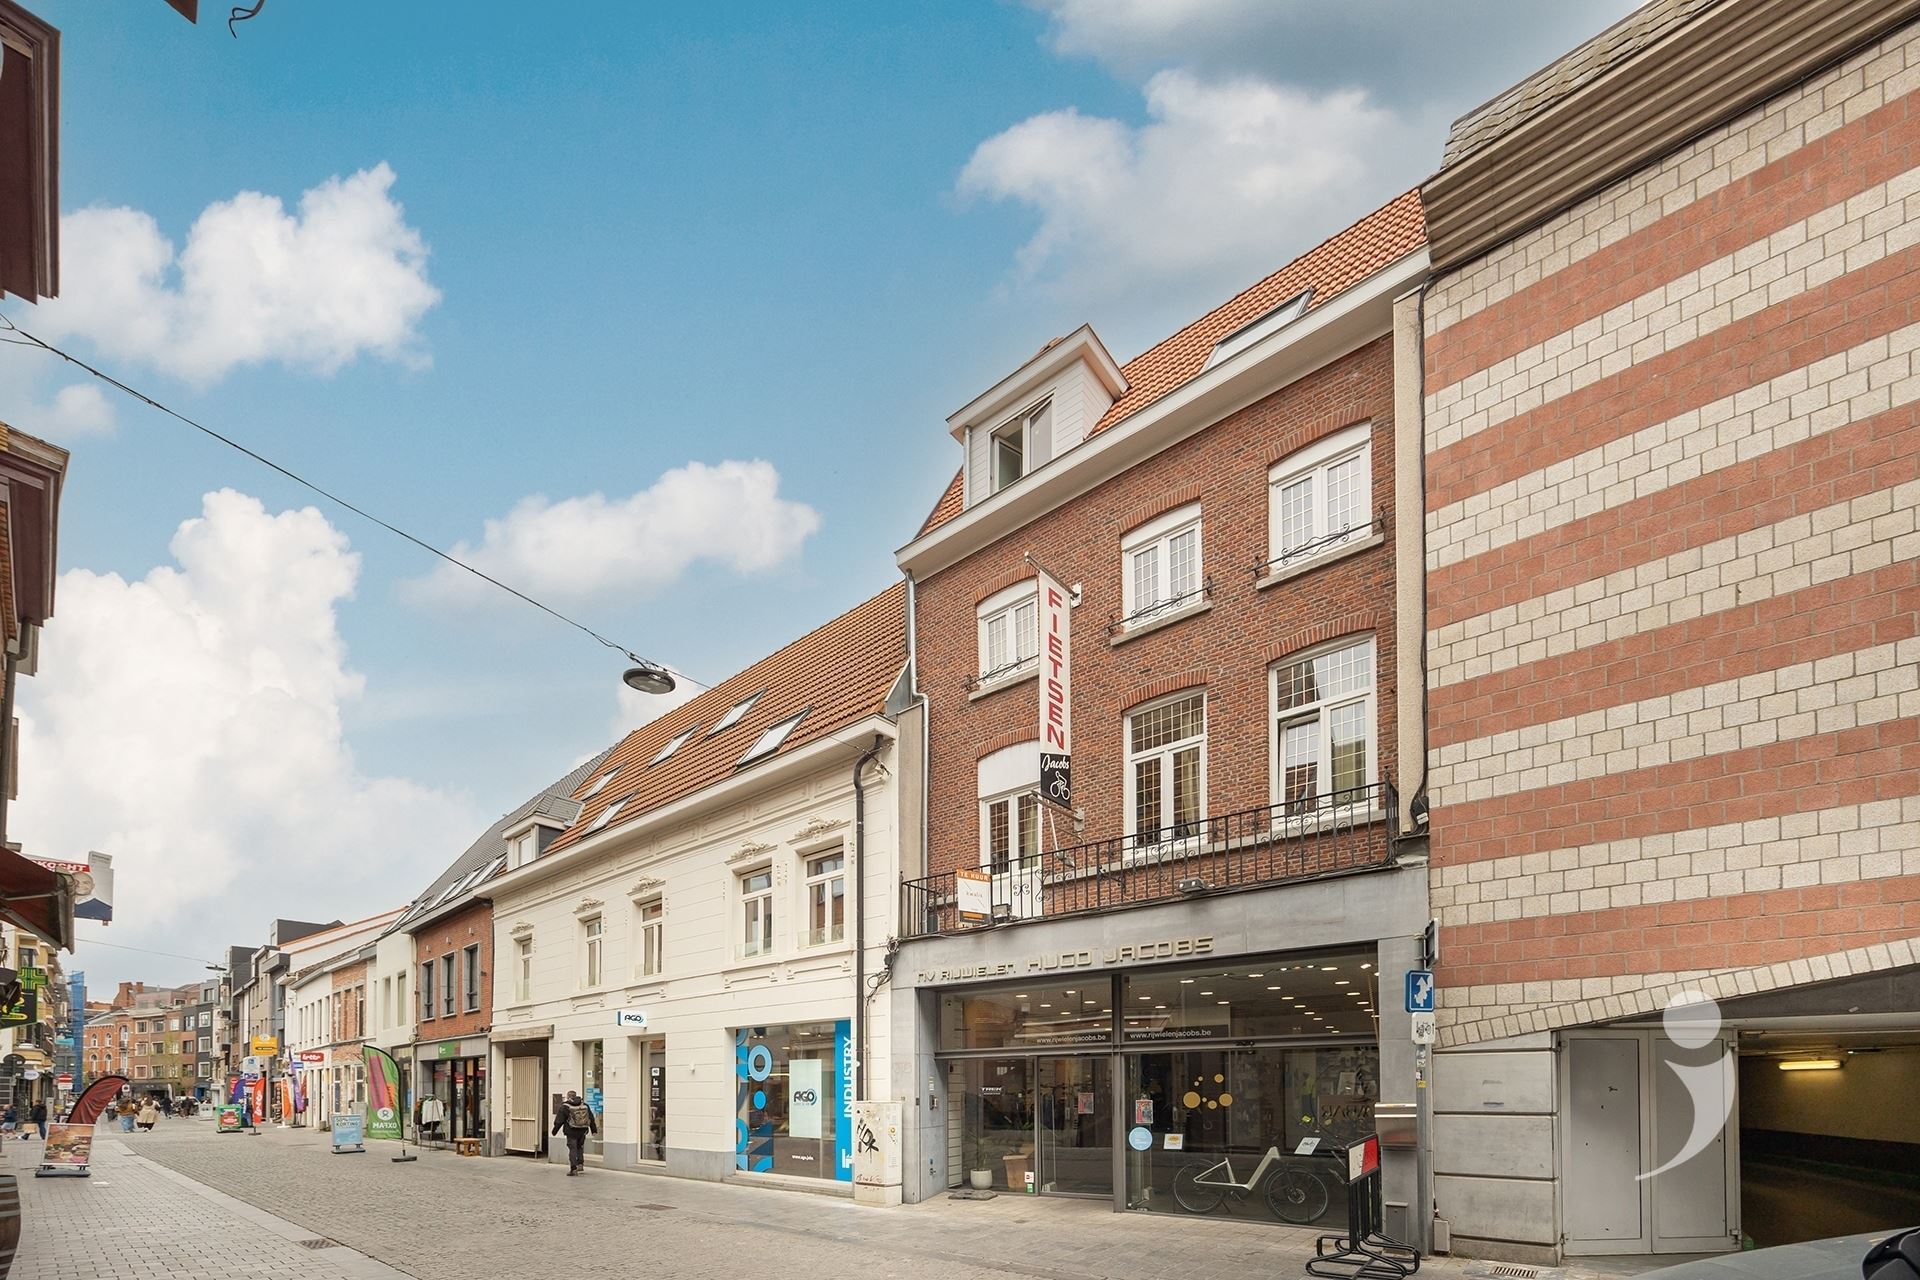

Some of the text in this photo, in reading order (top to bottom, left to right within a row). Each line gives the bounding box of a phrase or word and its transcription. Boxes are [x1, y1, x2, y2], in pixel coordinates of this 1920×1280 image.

[1047, 586, 1065, 751] FIETSEN
[1041, 754, 1070, 771] Jacobs
[941, 963, 1016, 981] RIJWIELEN
[1028, 951, 1092, 972] HUGO
[1104, 936, 1214, 964] JACOBS
[1129, 1029, 1212, 1040] www.rijwielenjacobs.be
[843, 1036, 852, 1118] INDUSTRY
